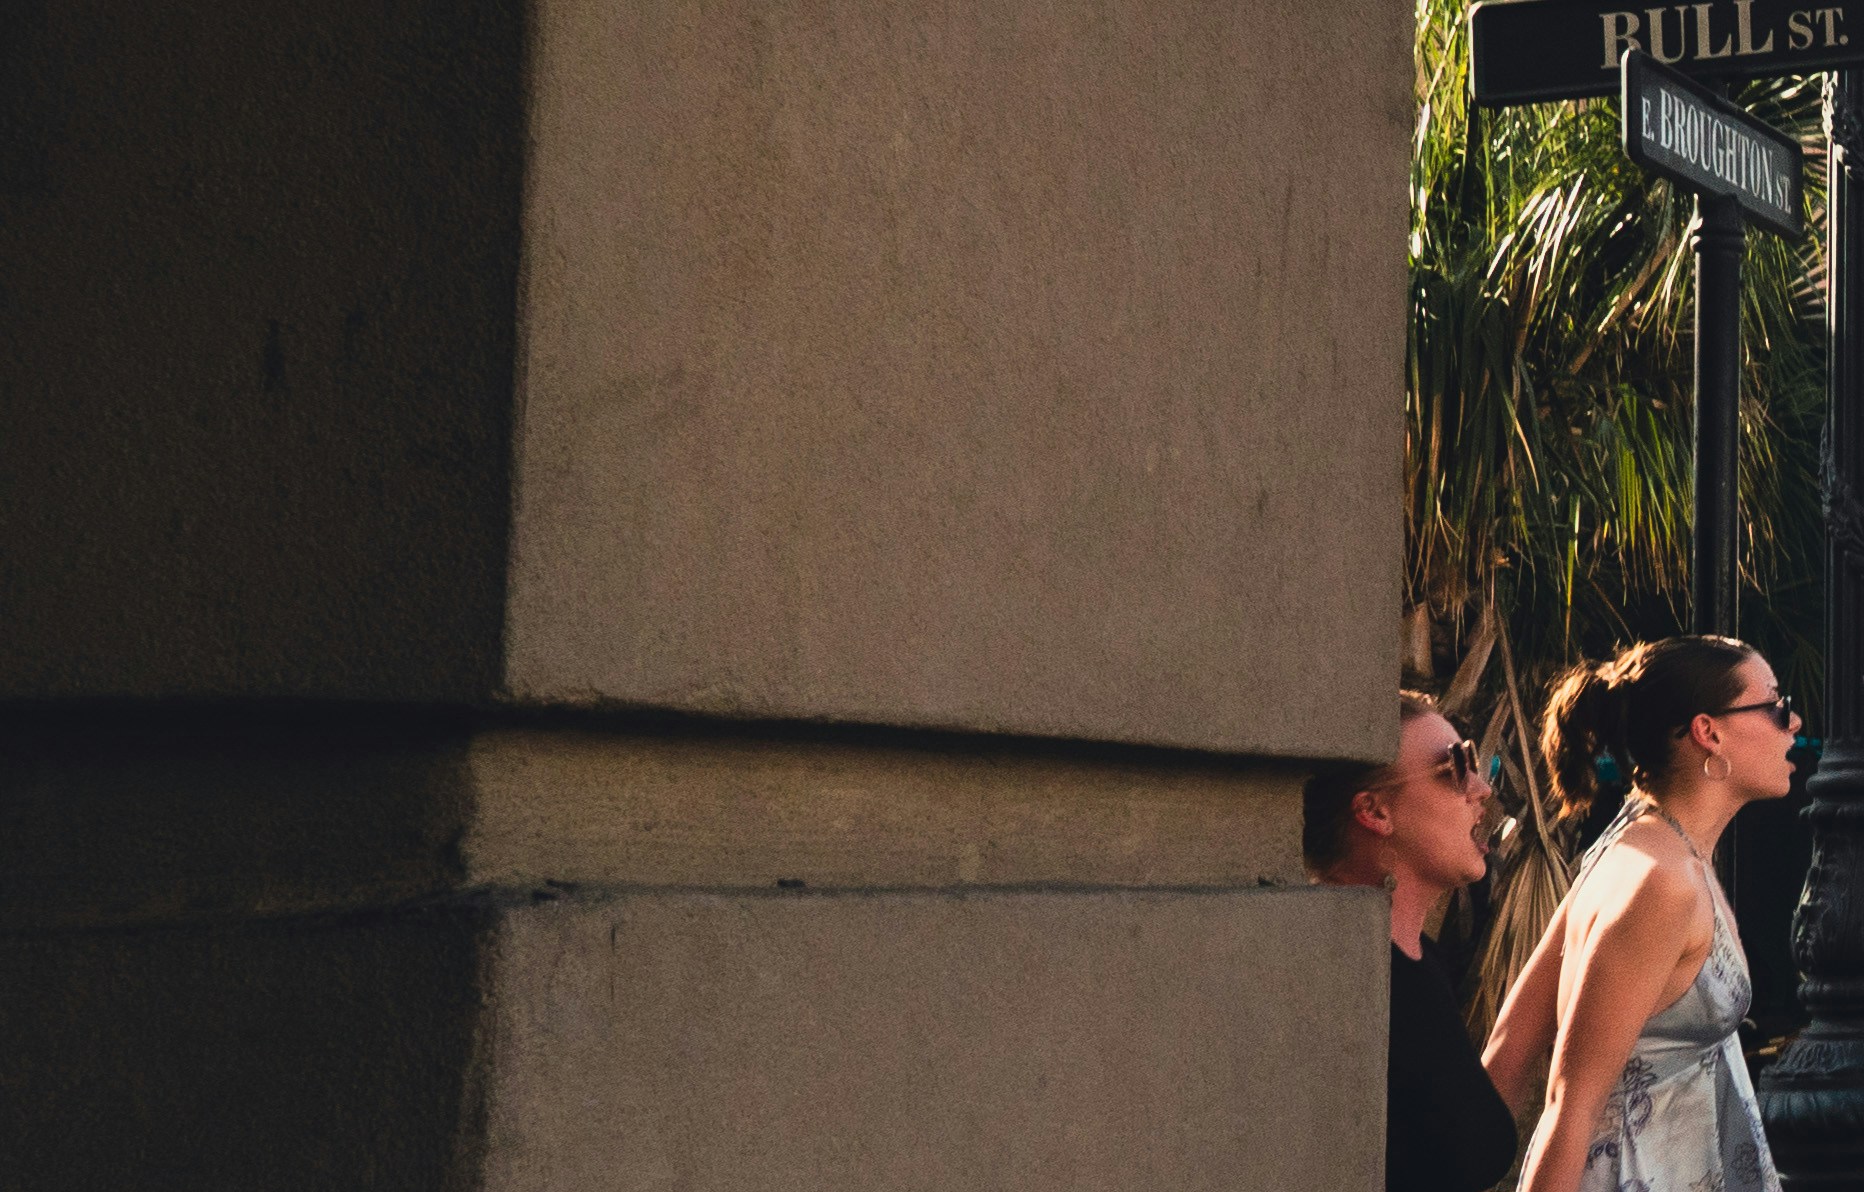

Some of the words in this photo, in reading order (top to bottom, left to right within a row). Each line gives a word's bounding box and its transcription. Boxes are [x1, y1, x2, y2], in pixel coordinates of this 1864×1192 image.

[1599, 0, 1774, 70] BULL
[1787, 7, 1850, 51] ST.
[1641, 96, 1655, 143] E.
[1659, 87, 1774, 205] BROUGHTON
